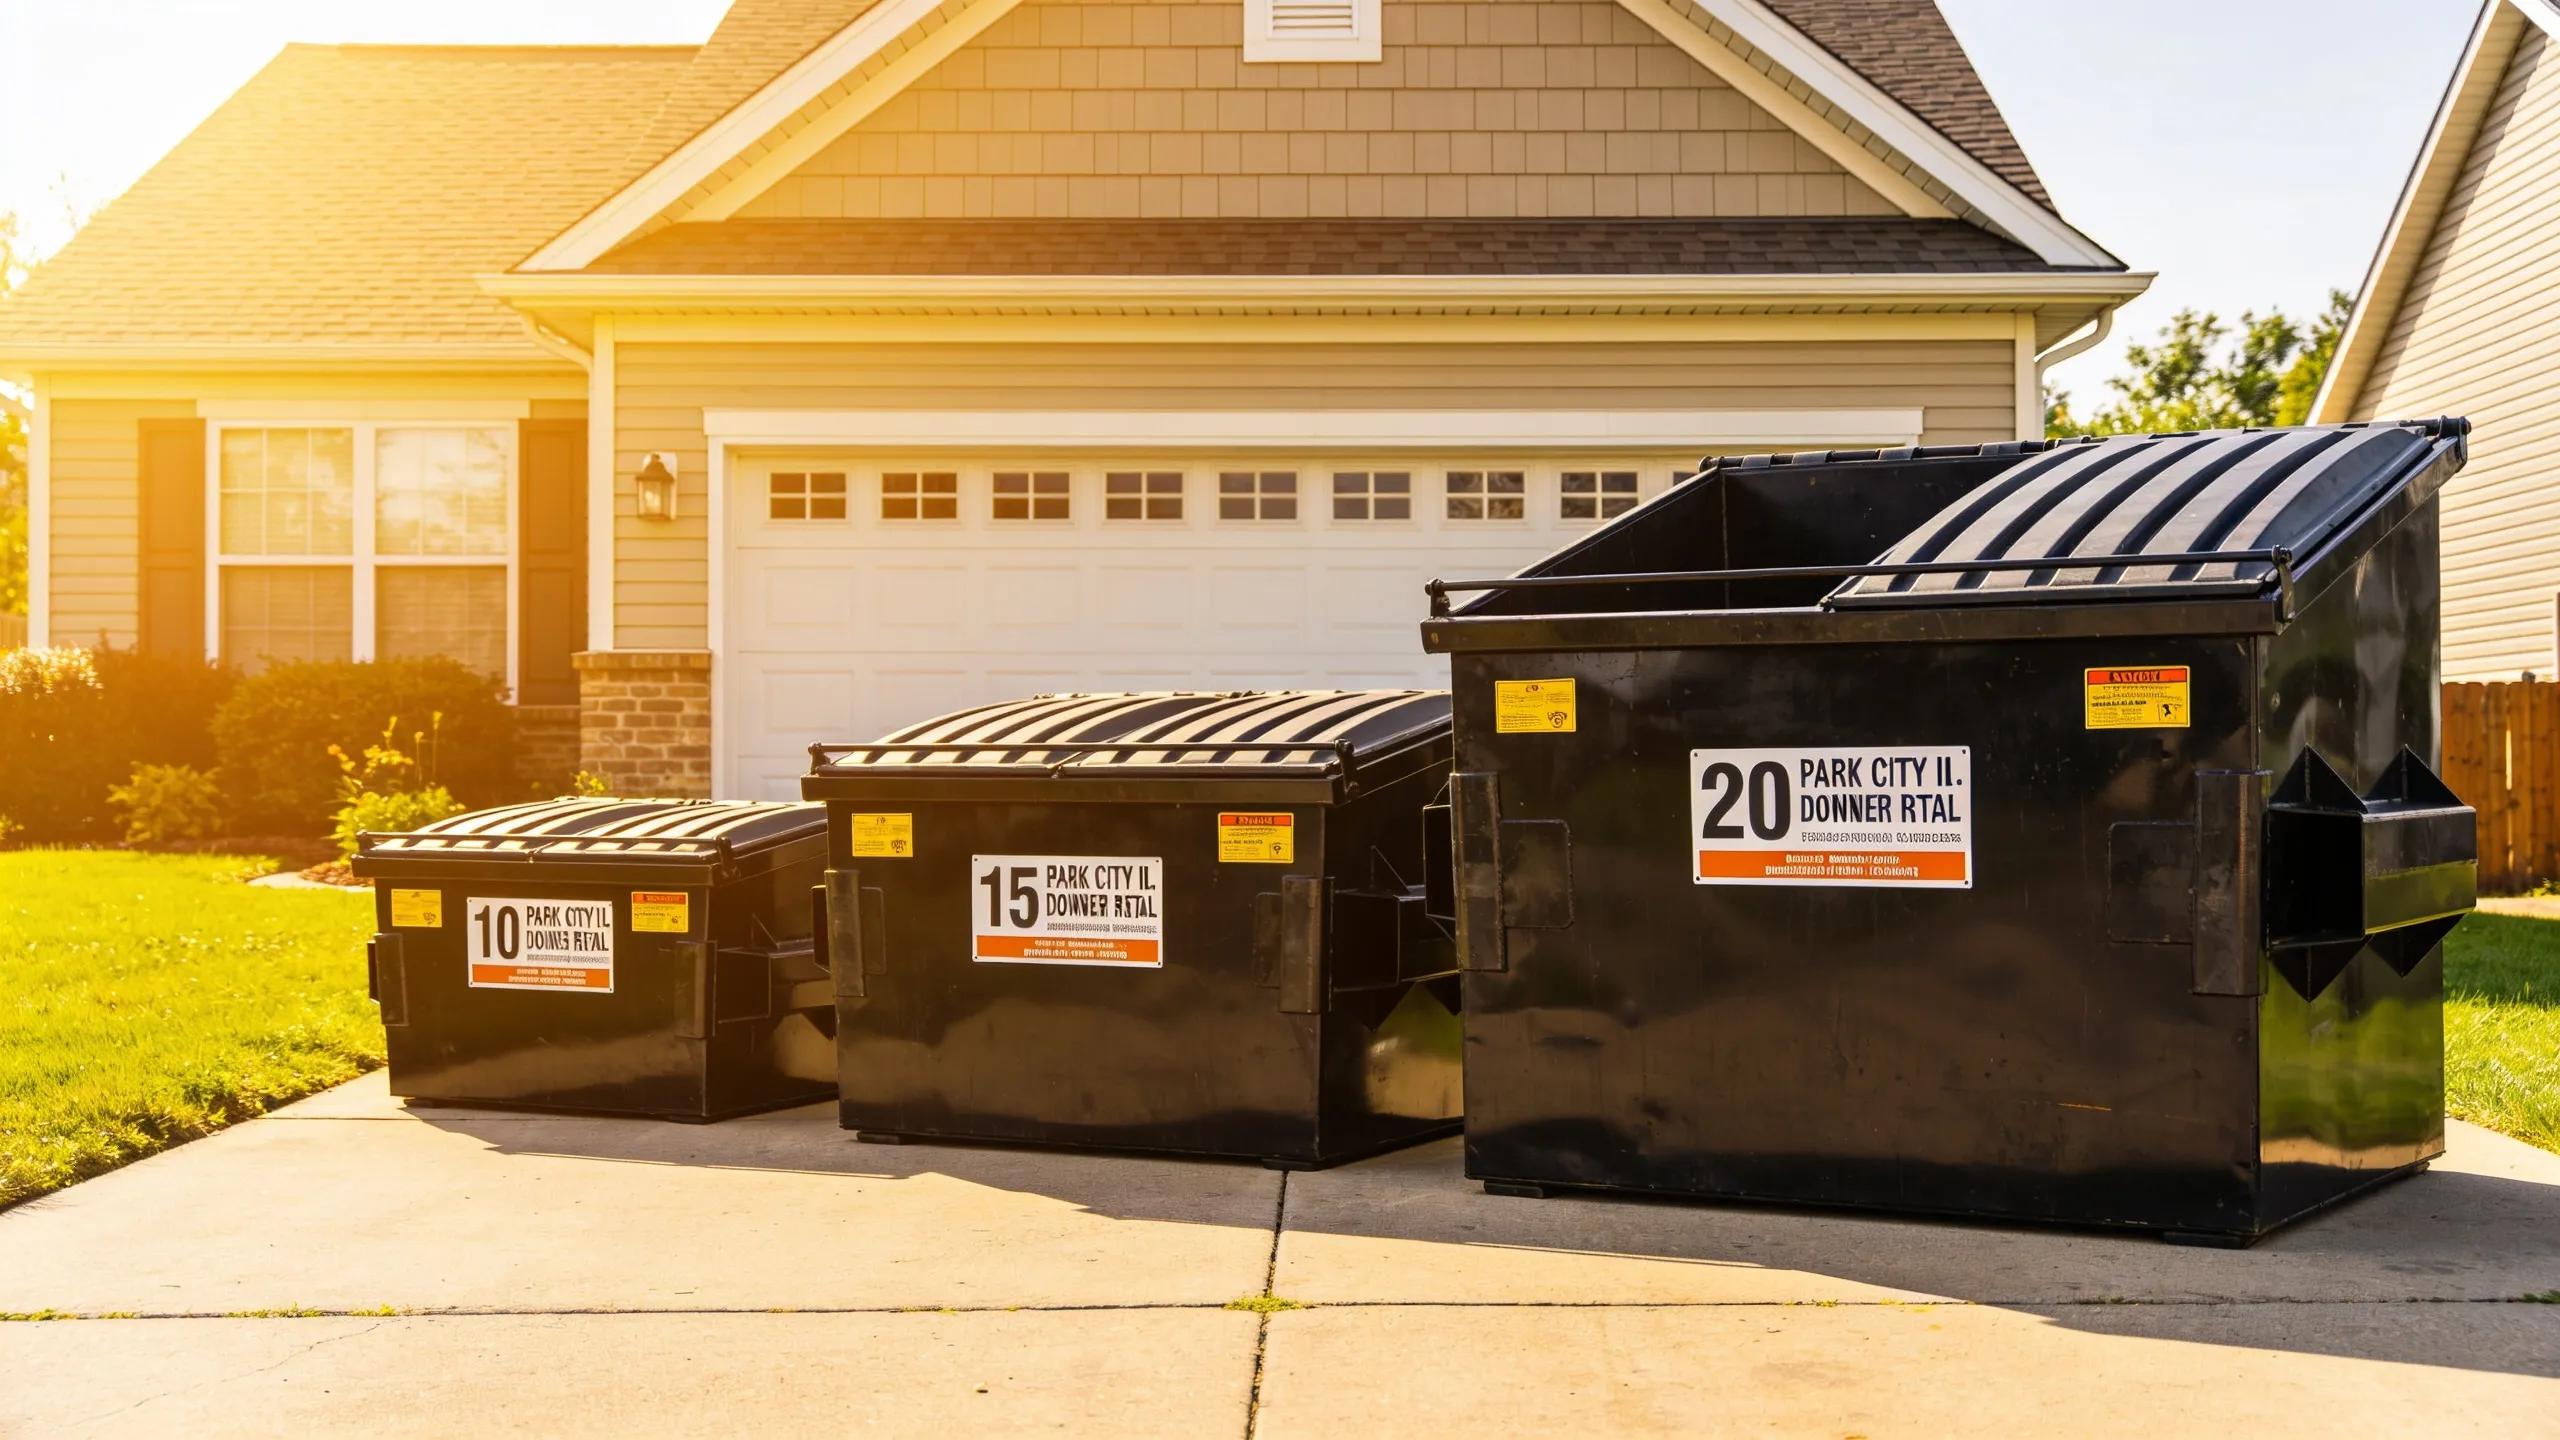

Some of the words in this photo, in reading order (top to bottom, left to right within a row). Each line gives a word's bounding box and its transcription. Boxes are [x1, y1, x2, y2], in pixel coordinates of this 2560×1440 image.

[1800, 757, 1862, 788] PARK
[1871, 757, 1927, 787] CITY
[1701, 761, 1791, 840] 20
[1800, 794, 1891, 823] DONNER
[1901, 794, 1961, 823] RTAL
[1047, 865, 1089, 889] PARK
[1095, 865, 1133, 890] CITY
[980, 865, 1039, 929] 15
[526, 906, 561, 927] PARK
[474, 905, 519, 960] 10
